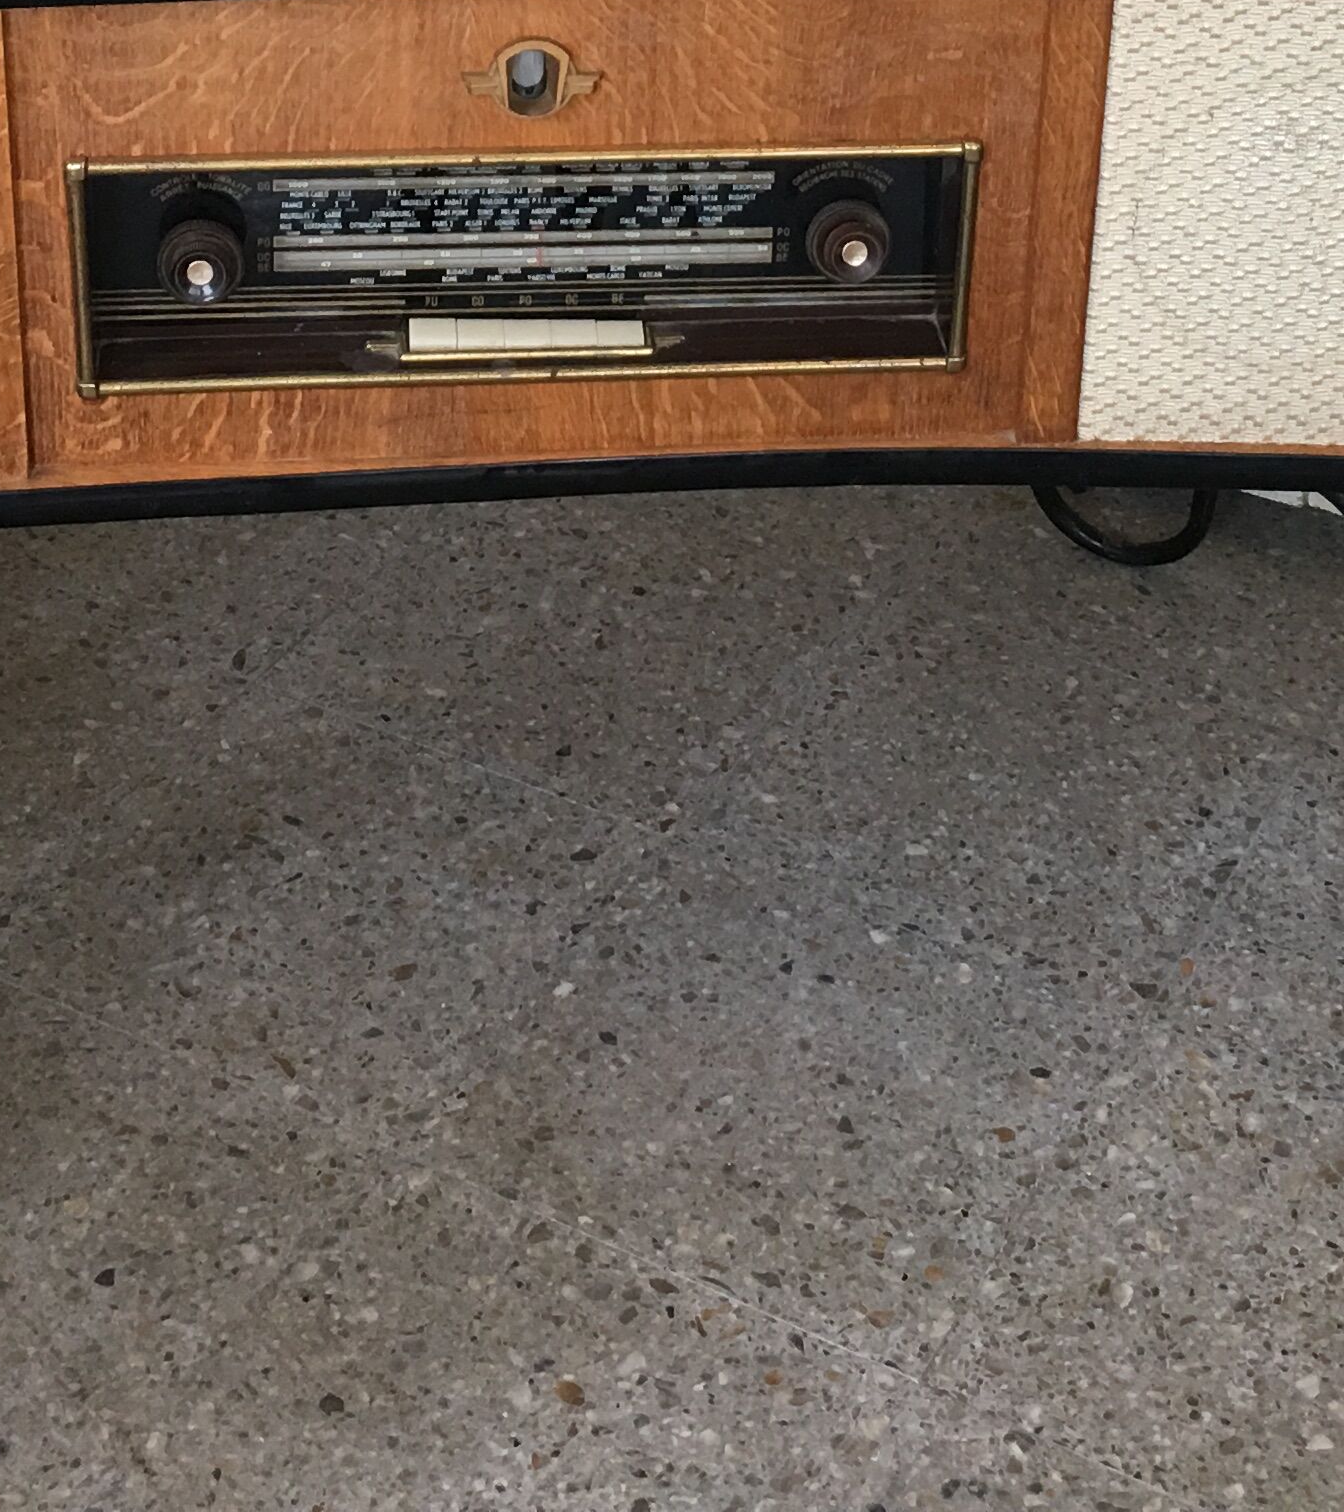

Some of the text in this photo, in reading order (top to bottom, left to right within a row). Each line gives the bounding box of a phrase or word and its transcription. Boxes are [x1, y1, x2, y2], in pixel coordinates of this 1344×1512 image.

[777, 228, 790, 236] PO
[424, 296, 438, 307] PU
[519, 295, 532, 305] PO
